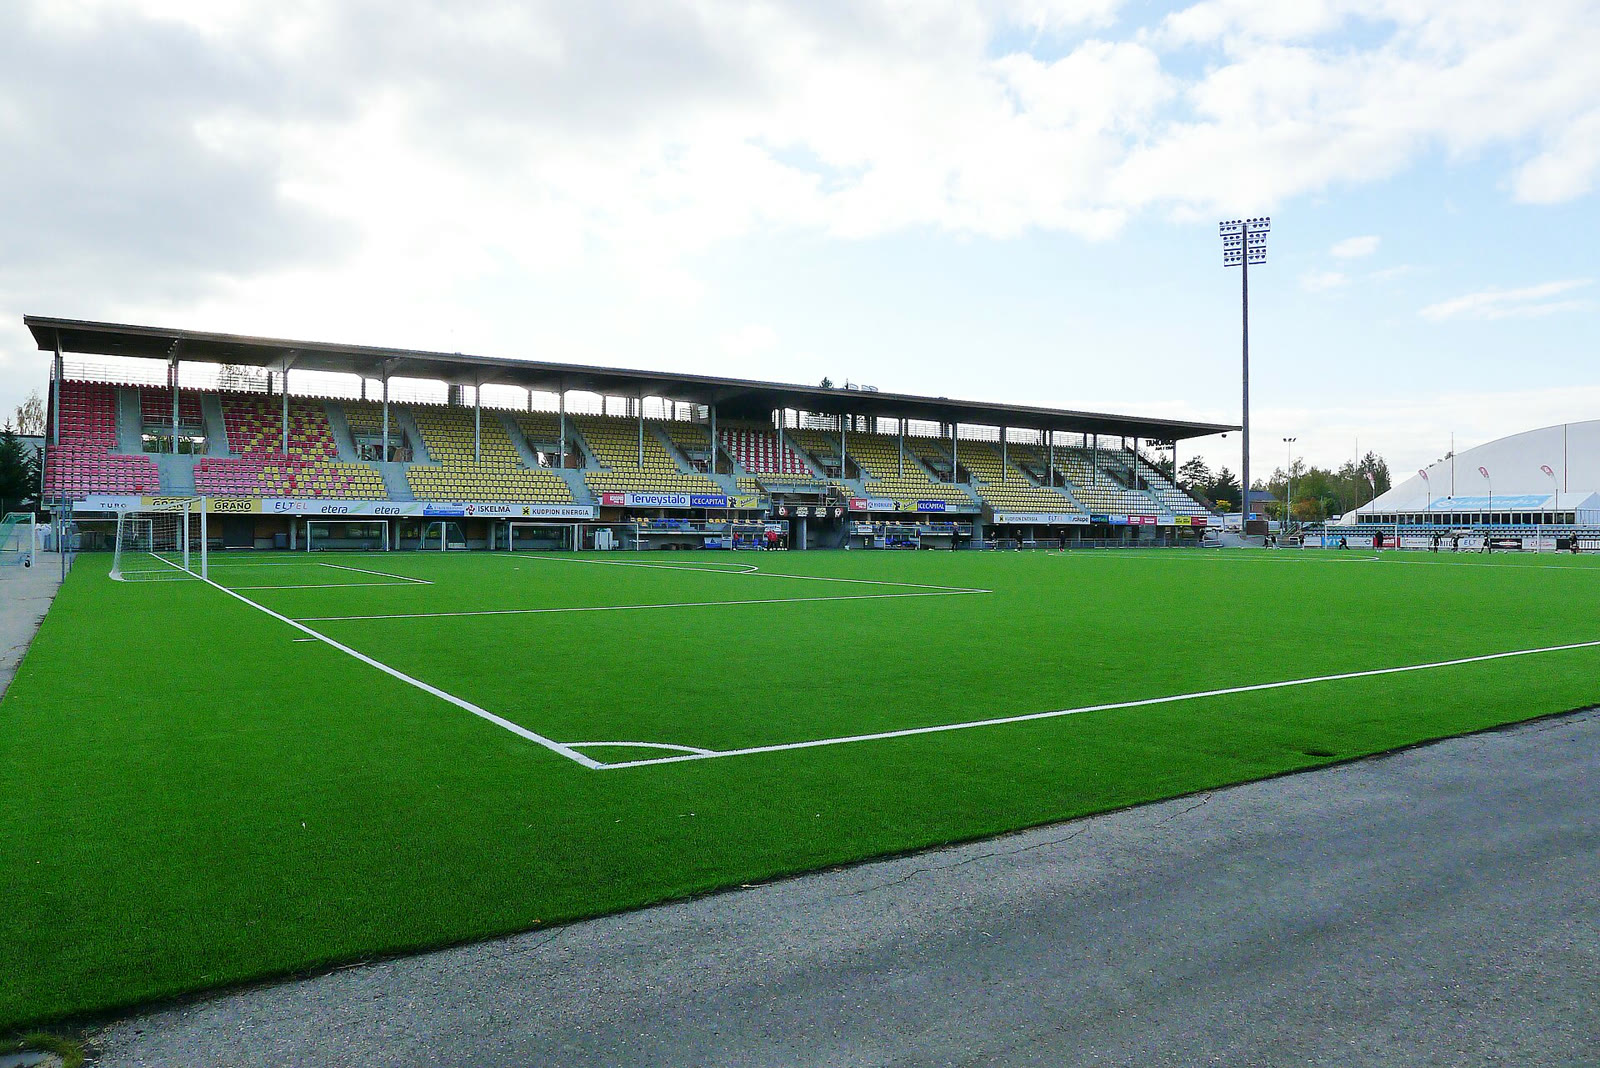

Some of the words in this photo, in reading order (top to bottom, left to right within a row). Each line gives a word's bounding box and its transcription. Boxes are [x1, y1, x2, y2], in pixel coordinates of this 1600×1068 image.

[630, 493, 686, 506] Terveystalo
[691, 497, 725, 505] ICECAPITAL
[214, 501, 252, 510] GRANO
[275, 501, 308, 510] ELTEL
[321, 505, 348, 514] etera
[477, 504, 511, 513] ISKELMÄ
[917, 502, 945, 510] ICECAPITAL
[374, 506, 400, 515] etera
